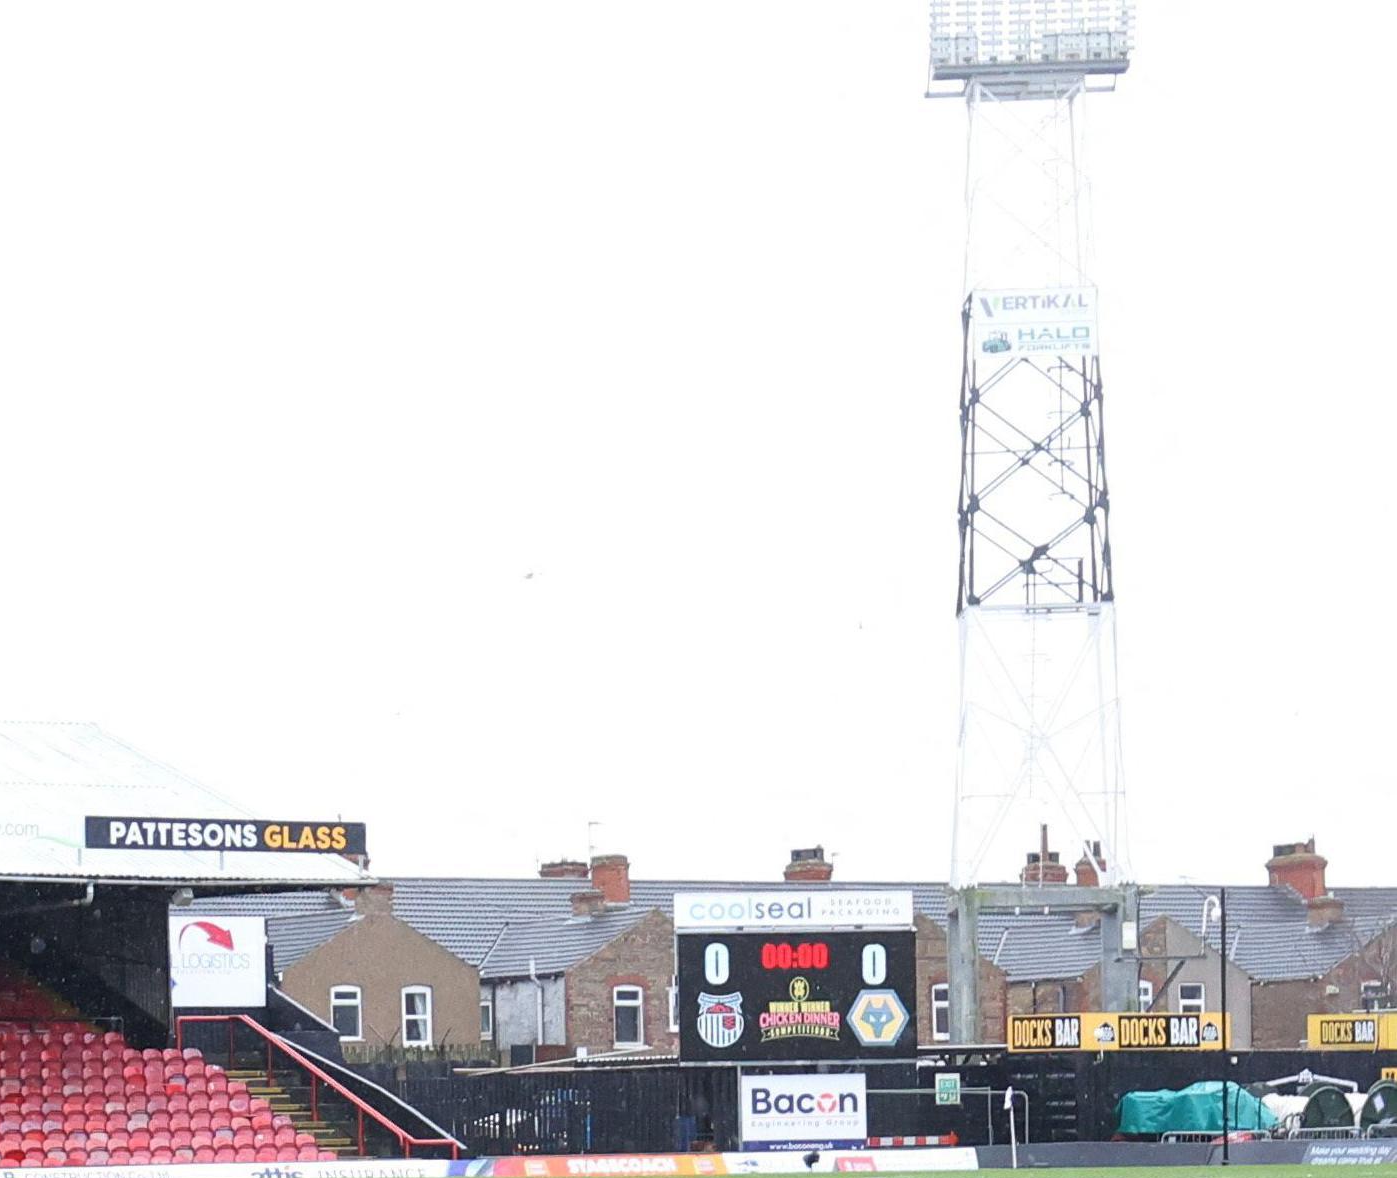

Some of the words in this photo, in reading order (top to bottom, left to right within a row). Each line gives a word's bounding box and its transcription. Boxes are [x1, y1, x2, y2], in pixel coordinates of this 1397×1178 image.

[1017, 326, 1090, 341] HALO
[110, 821, 258, 848] PATTESONS
[264, 825, 347, 850] GLASS
[690, 897, 812, 921] coolseal
[705, 942, 729, 985] 0
[762, 943, 830, 969] 00:00
[862, 944, 886, 985] 0
[760, 1013, 802, 1027] CHICKEN
[803, 1012, 840, 1026] DINNER
[769, 1002, 799, 1013] WINNER
[801, 1002, 831, 1013] WINNER
[1013, 1019, 1053, 1047] DOCKS
[1055, 1018, 1080, 1046] BAR
[1120, 1018, 1166, 1046] DOCKS
[1170, 1017, 1199, 1045] BAR
[1322, 1021, 1353, 1042] DOCKS
[1355, 1020, 1375, 1042] BAR
[751, 1088, 858, 1114] Bacon
